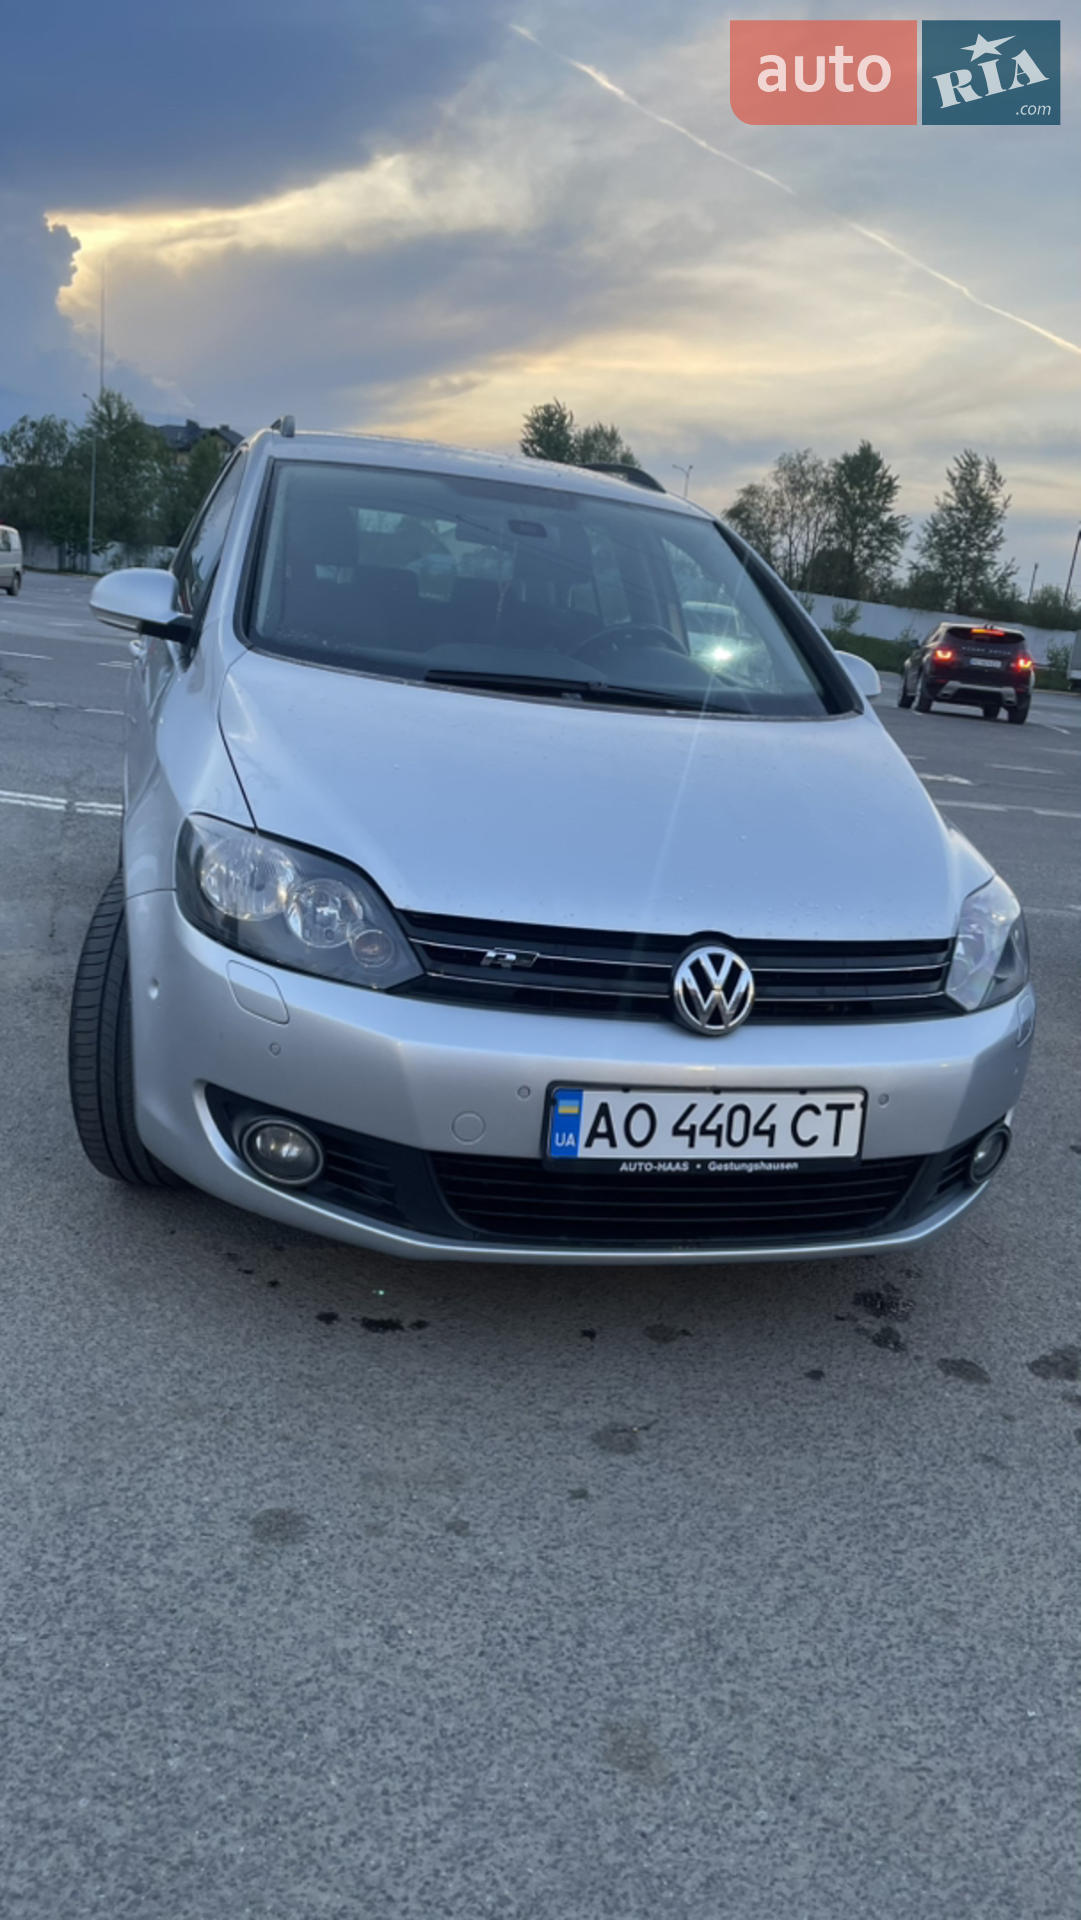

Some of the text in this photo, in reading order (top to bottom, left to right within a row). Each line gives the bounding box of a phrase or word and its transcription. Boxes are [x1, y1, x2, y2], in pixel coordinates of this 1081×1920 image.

[584, 1101, 856, 1149] AO 4404 CT
[554, 1132, 577, 1147] UA
[619, 1161, 690, 1173] AUTO-HAAS
